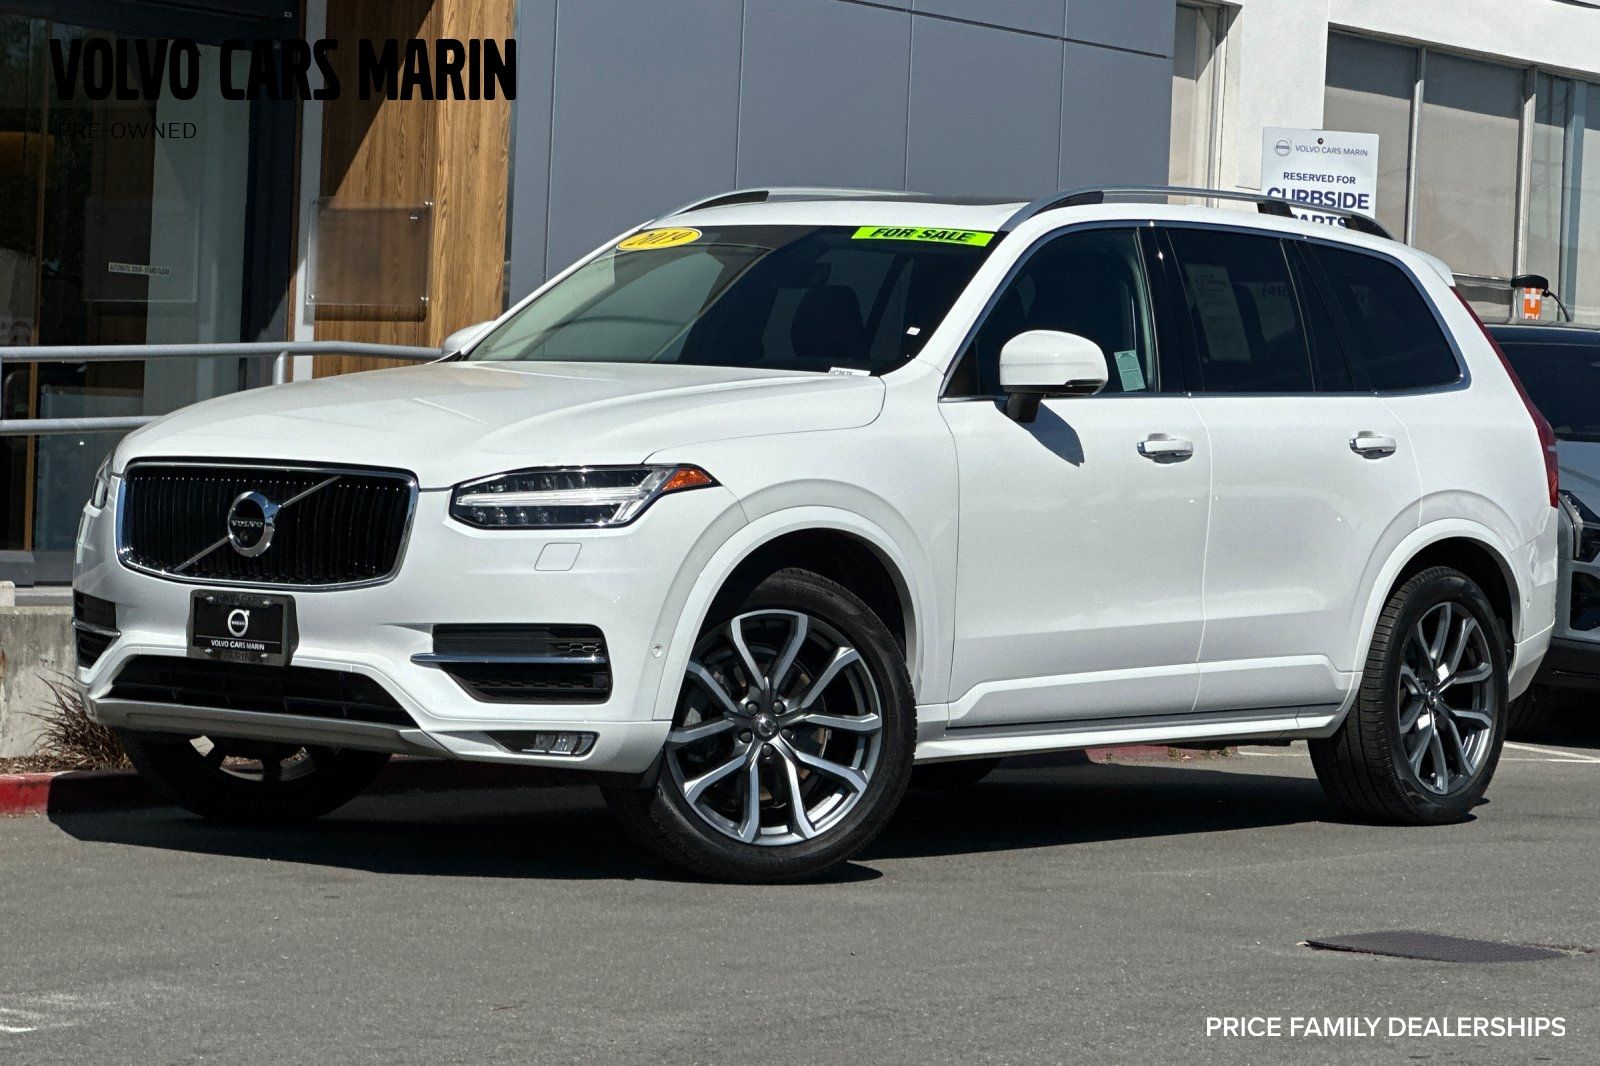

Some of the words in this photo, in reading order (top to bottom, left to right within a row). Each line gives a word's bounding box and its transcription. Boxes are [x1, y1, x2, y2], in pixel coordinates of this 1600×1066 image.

[1295, 145, 1320, 154] VOLVO
[1321, 147, 1342, 155] CARS
[1343, 148, 1368, 156] MARIN
[1283, 171, 1335, 183] RESERVED
[1336, 175, 1356, 185] FOR
[624, 230, 693, 247] 2019
[869, 227, 918, 238] FOR
[917, 229, 977, 242] SALE
[232, 520, 264, 528] VOLVO
[210, 639, 229, 648] VOLVO
[229, 641, 246, 649] CARS
[246, 642, 265, 651] MARIN
